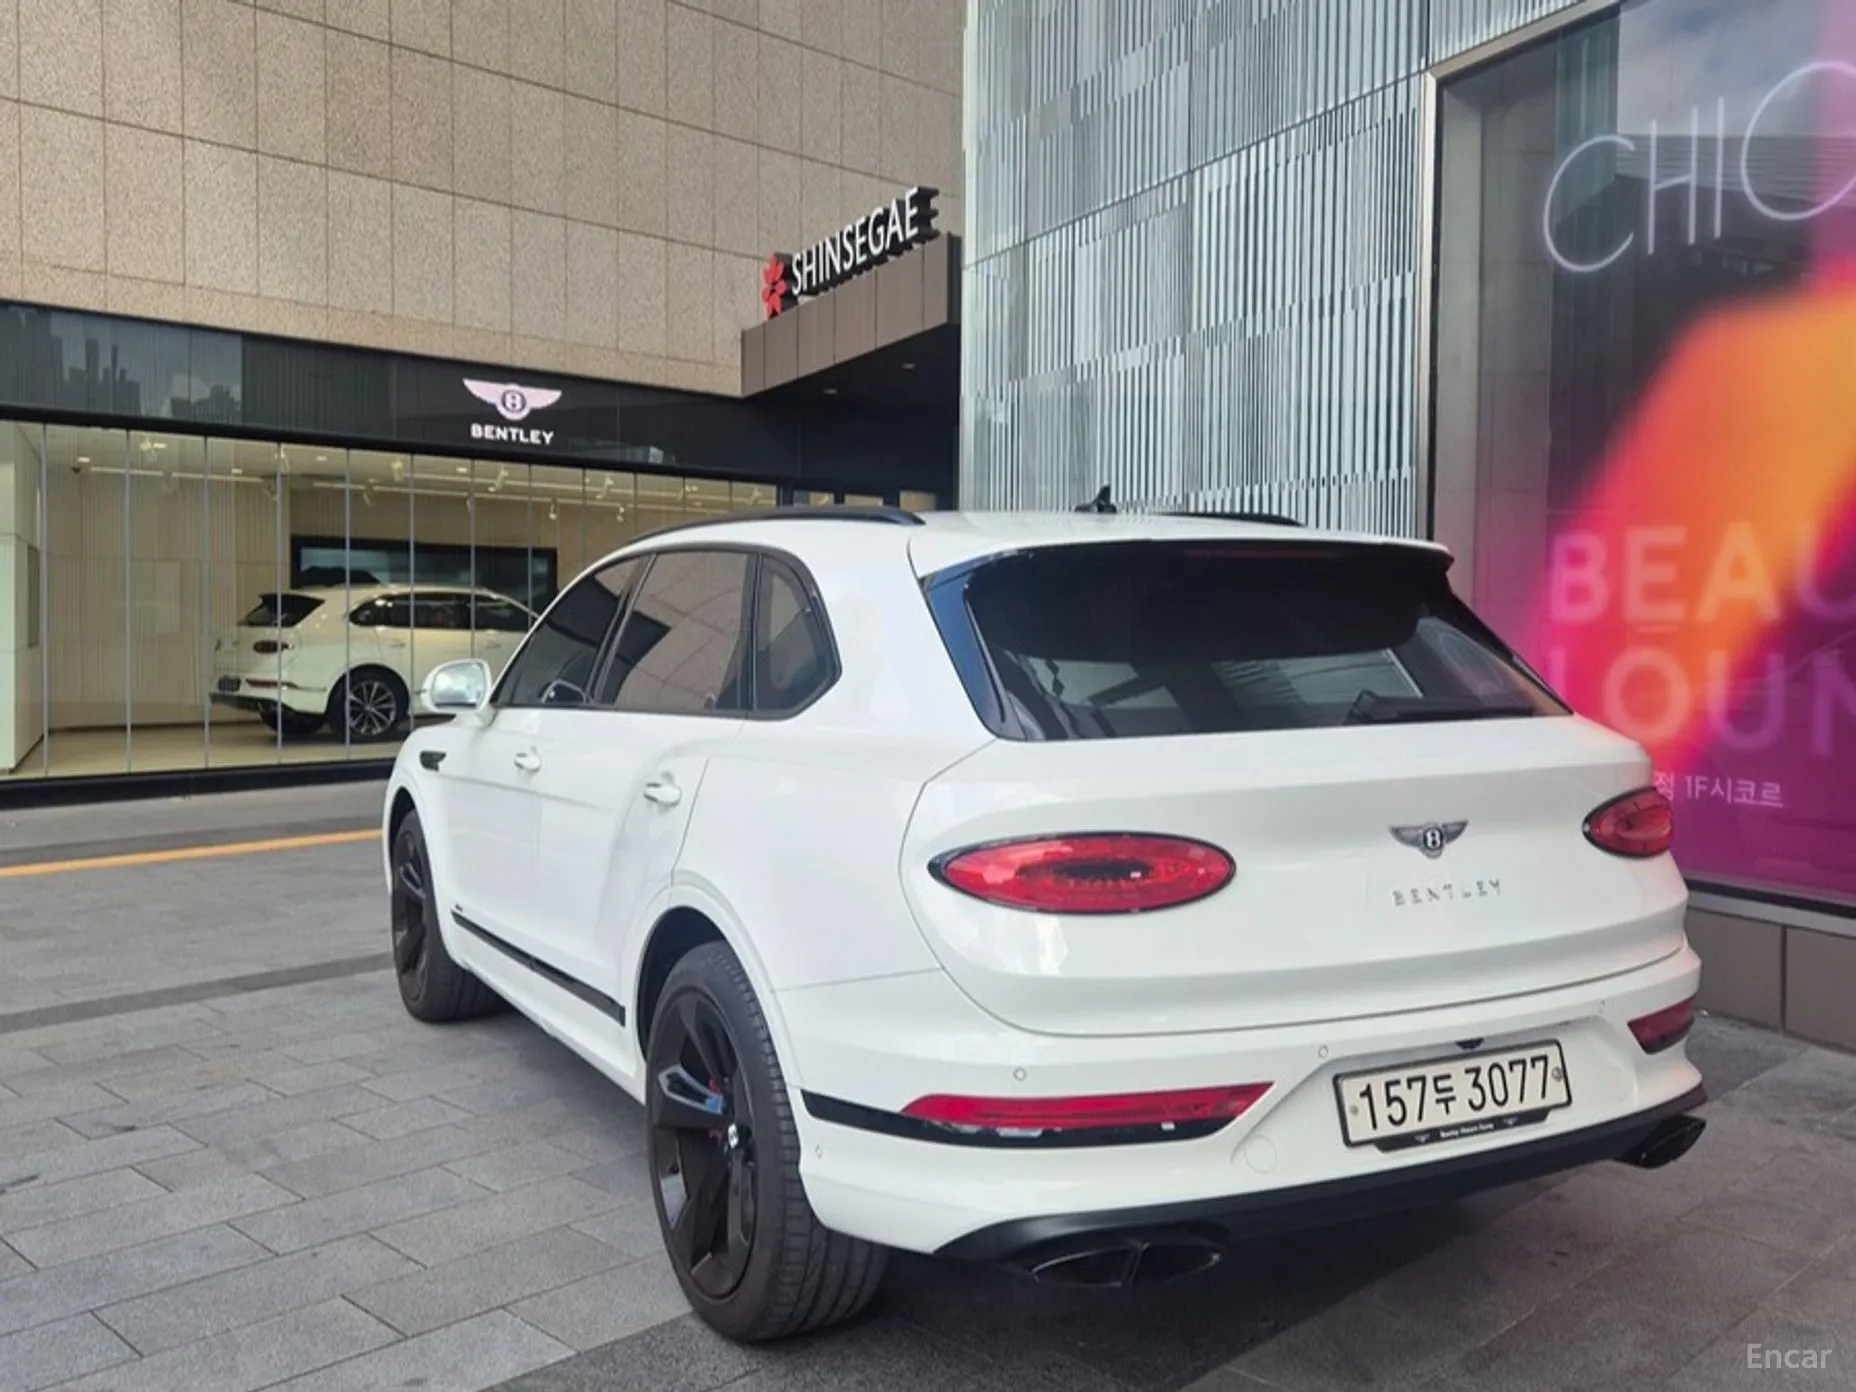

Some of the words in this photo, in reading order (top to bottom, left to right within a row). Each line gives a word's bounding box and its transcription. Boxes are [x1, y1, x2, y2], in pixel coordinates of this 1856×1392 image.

[791, 185, 921, 295] SHINSEGAE
[470, 422, 554, 445] BENTLEY
[1685, 775, 1784, 808] 1F시코르
[1392, 878, 1500, 907] BENTLEY
[1359, 1073, 1457, 1131] 157두
[1464, 1054, 1549, 1112] 3077
